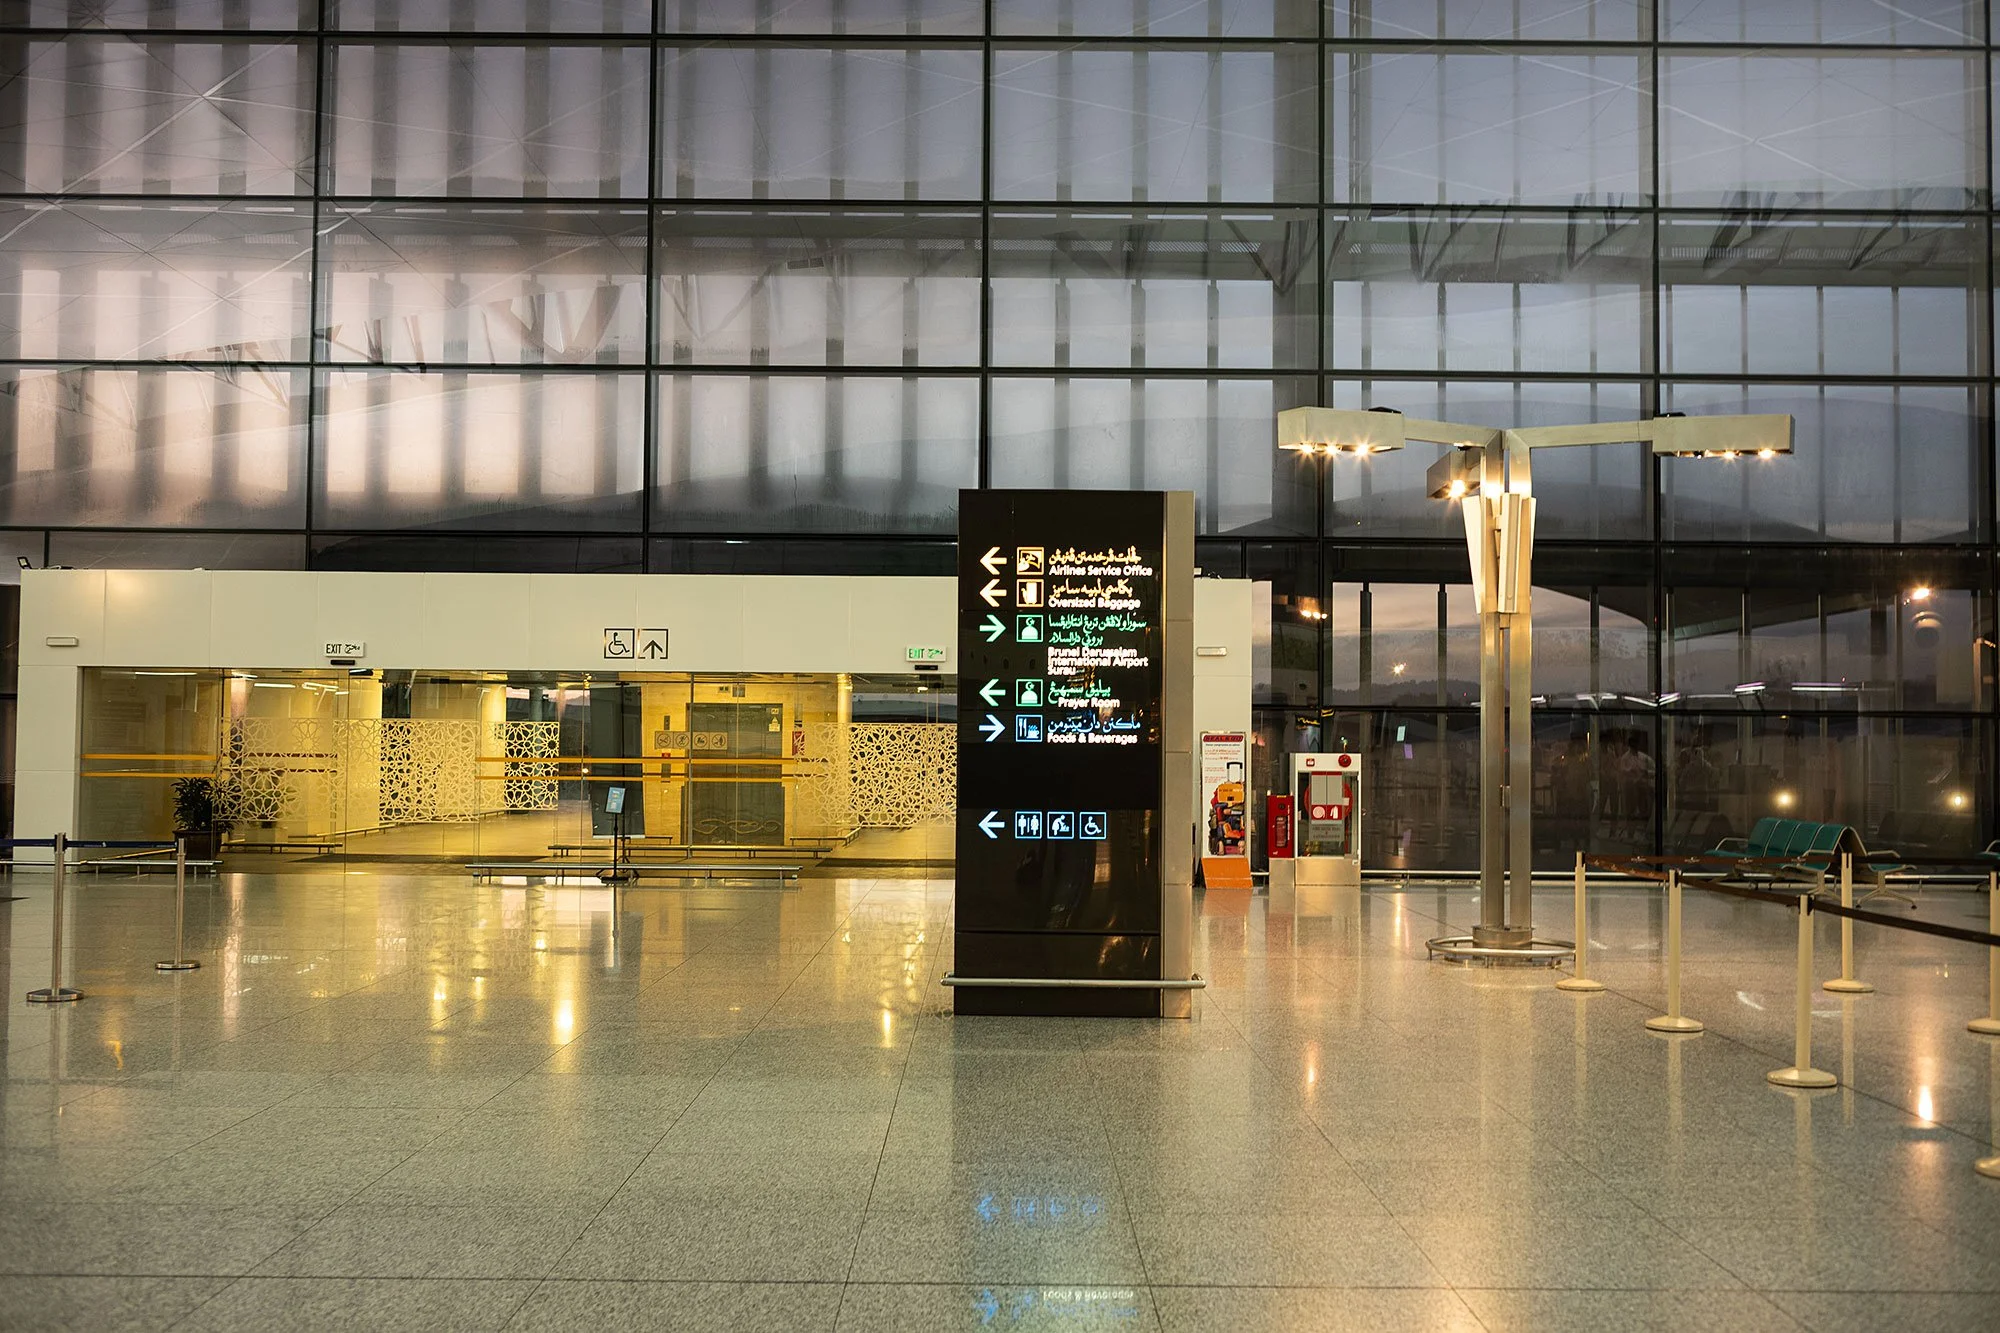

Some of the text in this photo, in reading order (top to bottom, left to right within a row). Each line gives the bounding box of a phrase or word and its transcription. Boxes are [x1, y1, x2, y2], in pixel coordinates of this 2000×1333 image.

[1048, 564, 1153, 576] Airlines Service Office
[1048, 596, 1142, 611] Oversized Baggage
[326, 643, 342, 654] EXIT
[908, 648, 925, 659] EXIT
[1047, 646, 1137, 657] Brunei Darussalam
[1047, 656, 1149, 669] International Airport
[1047, 666, 1076, 675] Surau
[1058, 697, 1120, 709] Prayer Room
[1047, 732, 1138, 745] Foods & Beverages
